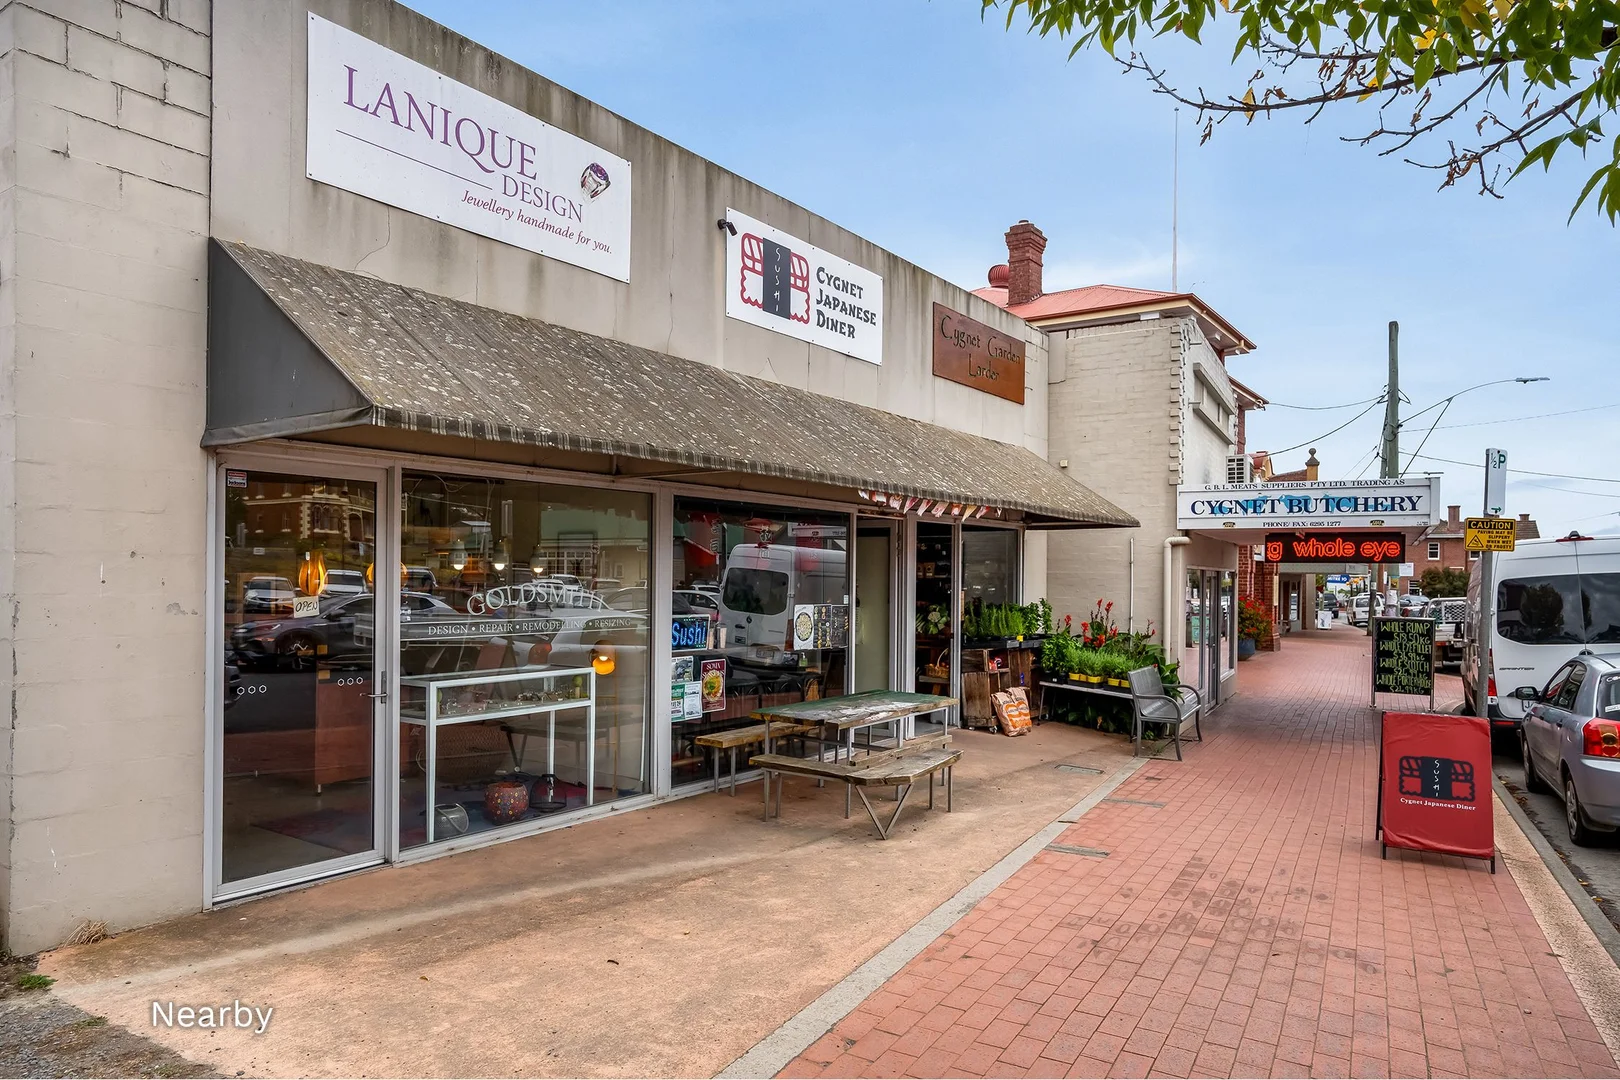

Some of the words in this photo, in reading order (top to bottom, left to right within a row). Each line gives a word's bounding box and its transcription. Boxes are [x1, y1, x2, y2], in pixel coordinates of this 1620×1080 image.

[343, 64, 538, 181] LANIQUE
[502, 174, 584, 223] DESIGN
[461, 190, 514, 221] Jewellery
[517, 209, 575, 240] handmade
[575, 230, 591, 245] for
[593, 239, 612, 255] you.
[773, 247, 781, 312] SUSHI
[816, 266, 864, 300] CYGNET
[816, 288, 877, 326] JAPANESE
[816, 309, 856, 339] DINER
[941, 314, 980, 349] Cygnet
[987, 336, 1021, 364] Garden
[968, 353, 1000, 381] Larder
[1350, 479, 1391, 487] TRADING
[1190, 499, 1281, 516] CYGNET
[1286, 495, 1423, 514] BUTCHERY
[1470, 521, 1512, 530] CAUTION
[1292, 537, 1356, 558] whole
[1360, 541, 1400, 562] eye
[295, 601, 318, 613] OPEN
[466, 583, 606, 616] GOLDSMITH
[428, 624, 469, 636] DESIGN
[479, 623, 513, 634] REPAIR
[522, 620, 587, 632] REMODELLING
[594, 618, 631, 628] RESIZING
[671, 621, 706, 646] Sushi
[1380, 621, 1405, 633] WHOLE
[1405, 621, 1431, 634] RUMP
[1379, 641, 1400, 652] WHOLE
[1380, 658, 1402, 669] WHOLE
[1403, 660, 1430, 673] SCOTCH
[1432, 759, 1440, 798] SUSHI
[1400, 797, 1423, 805] Cygnet
[1424, 800, 1455, 809] Japanese
[1456, 803, 1476, 811] Diner
